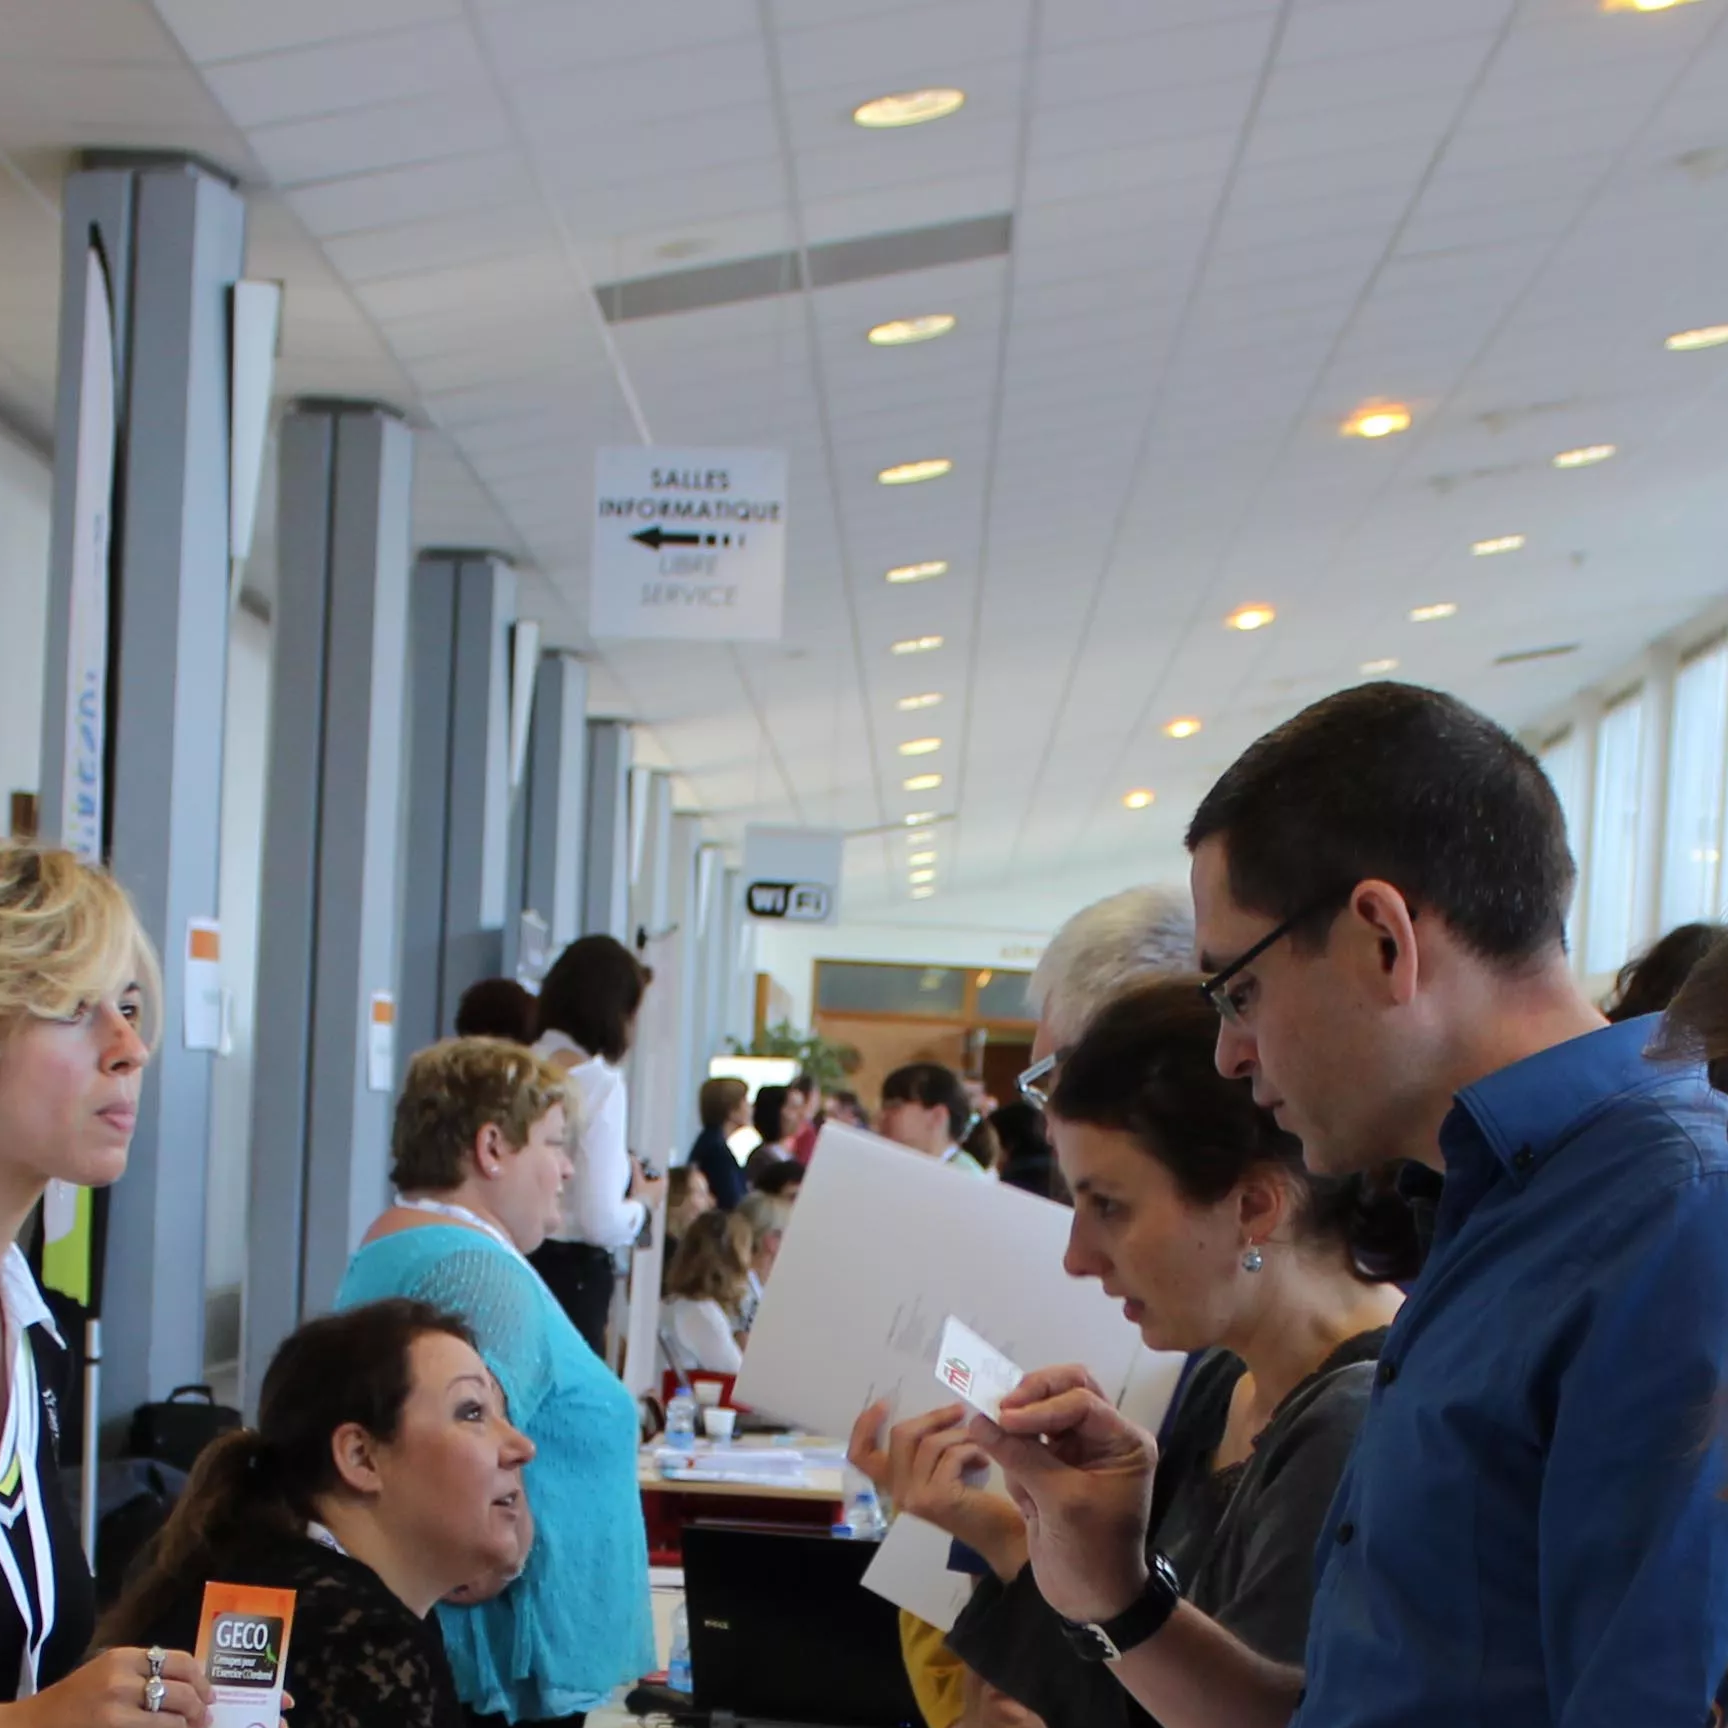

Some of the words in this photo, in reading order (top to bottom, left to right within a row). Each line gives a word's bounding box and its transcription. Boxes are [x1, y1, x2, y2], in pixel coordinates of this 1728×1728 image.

[651, 467, 730, 491] SALLES
[599, 497, 780, 521] INFORMATIQUE
[216, 1620, 268, 1651] GECO
